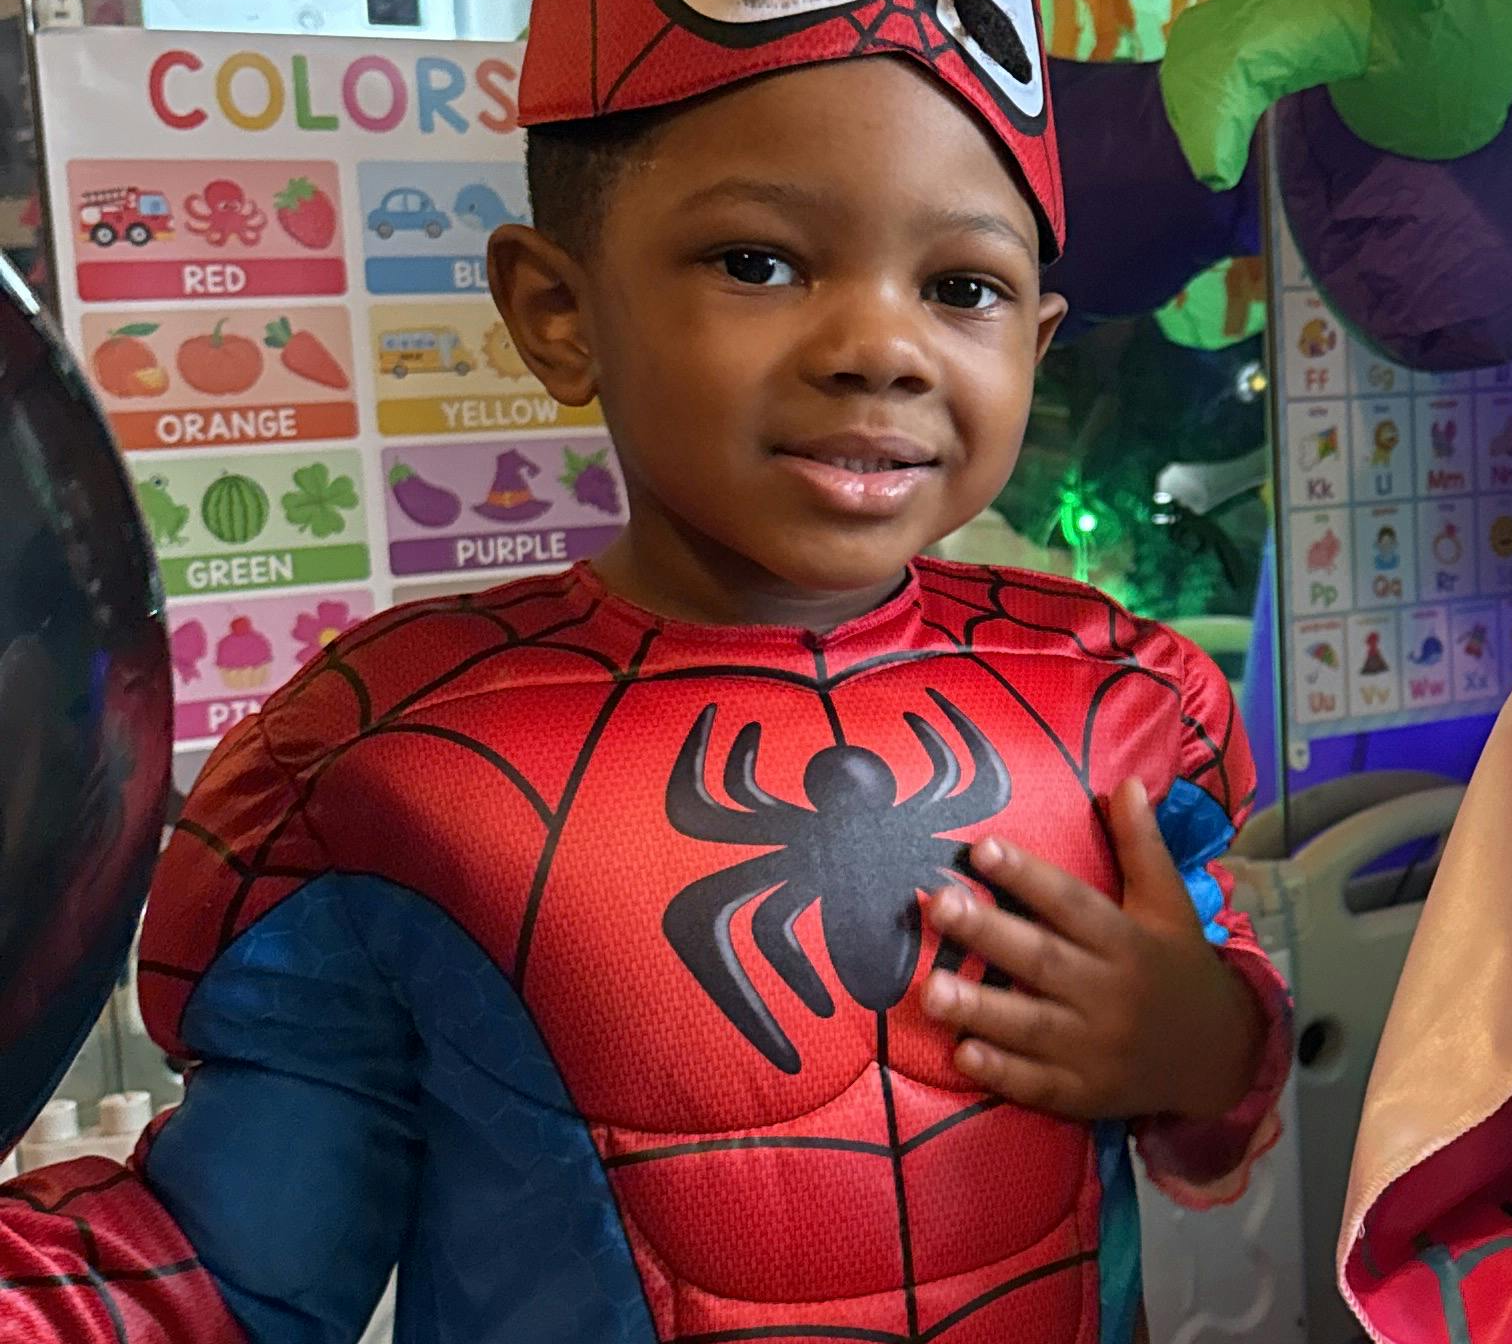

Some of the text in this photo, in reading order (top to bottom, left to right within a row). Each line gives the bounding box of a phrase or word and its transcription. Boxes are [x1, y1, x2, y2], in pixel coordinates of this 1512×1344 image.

[148, 50, 522, 135] COLORS
[183, 264, 247, 296] RED
[453, 260, 489, 289] BL
[155, 410, 298, 446] ORANGE
[440, 399, 560, 428] YELLOW
[1307, 479, 1334, 501] Kk
[456, 533, 568, 565] PURPLE
[186, 555, 295, 588] GREEN
[1310, 580, 1339, 608] Pp
[1308, 690, 1337, 714] Uu
[1409, 677, 1446, 700] Ww
[208, 701, 262, 732] PI
